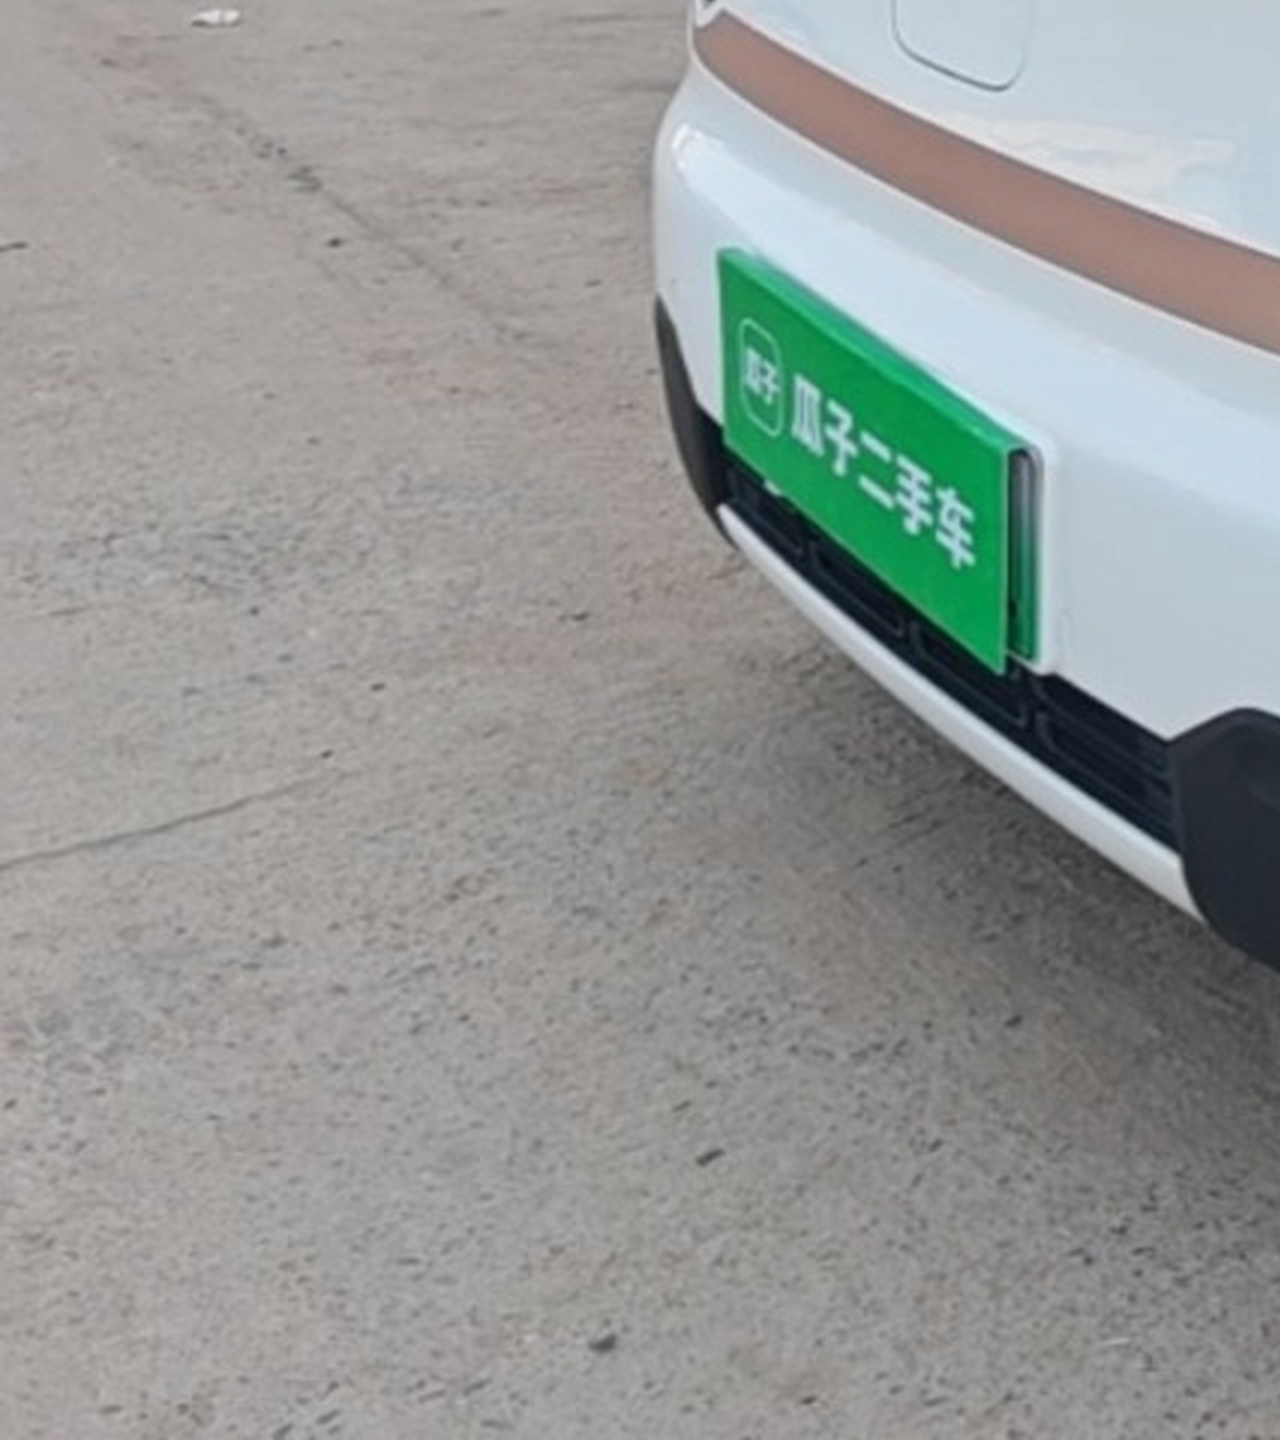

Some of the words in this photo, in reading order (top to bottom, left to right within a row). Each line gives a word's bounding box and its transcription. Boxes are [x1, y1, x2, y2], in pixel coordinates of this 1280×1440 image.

[791, 373, 976, 571] 瓜子二手车
